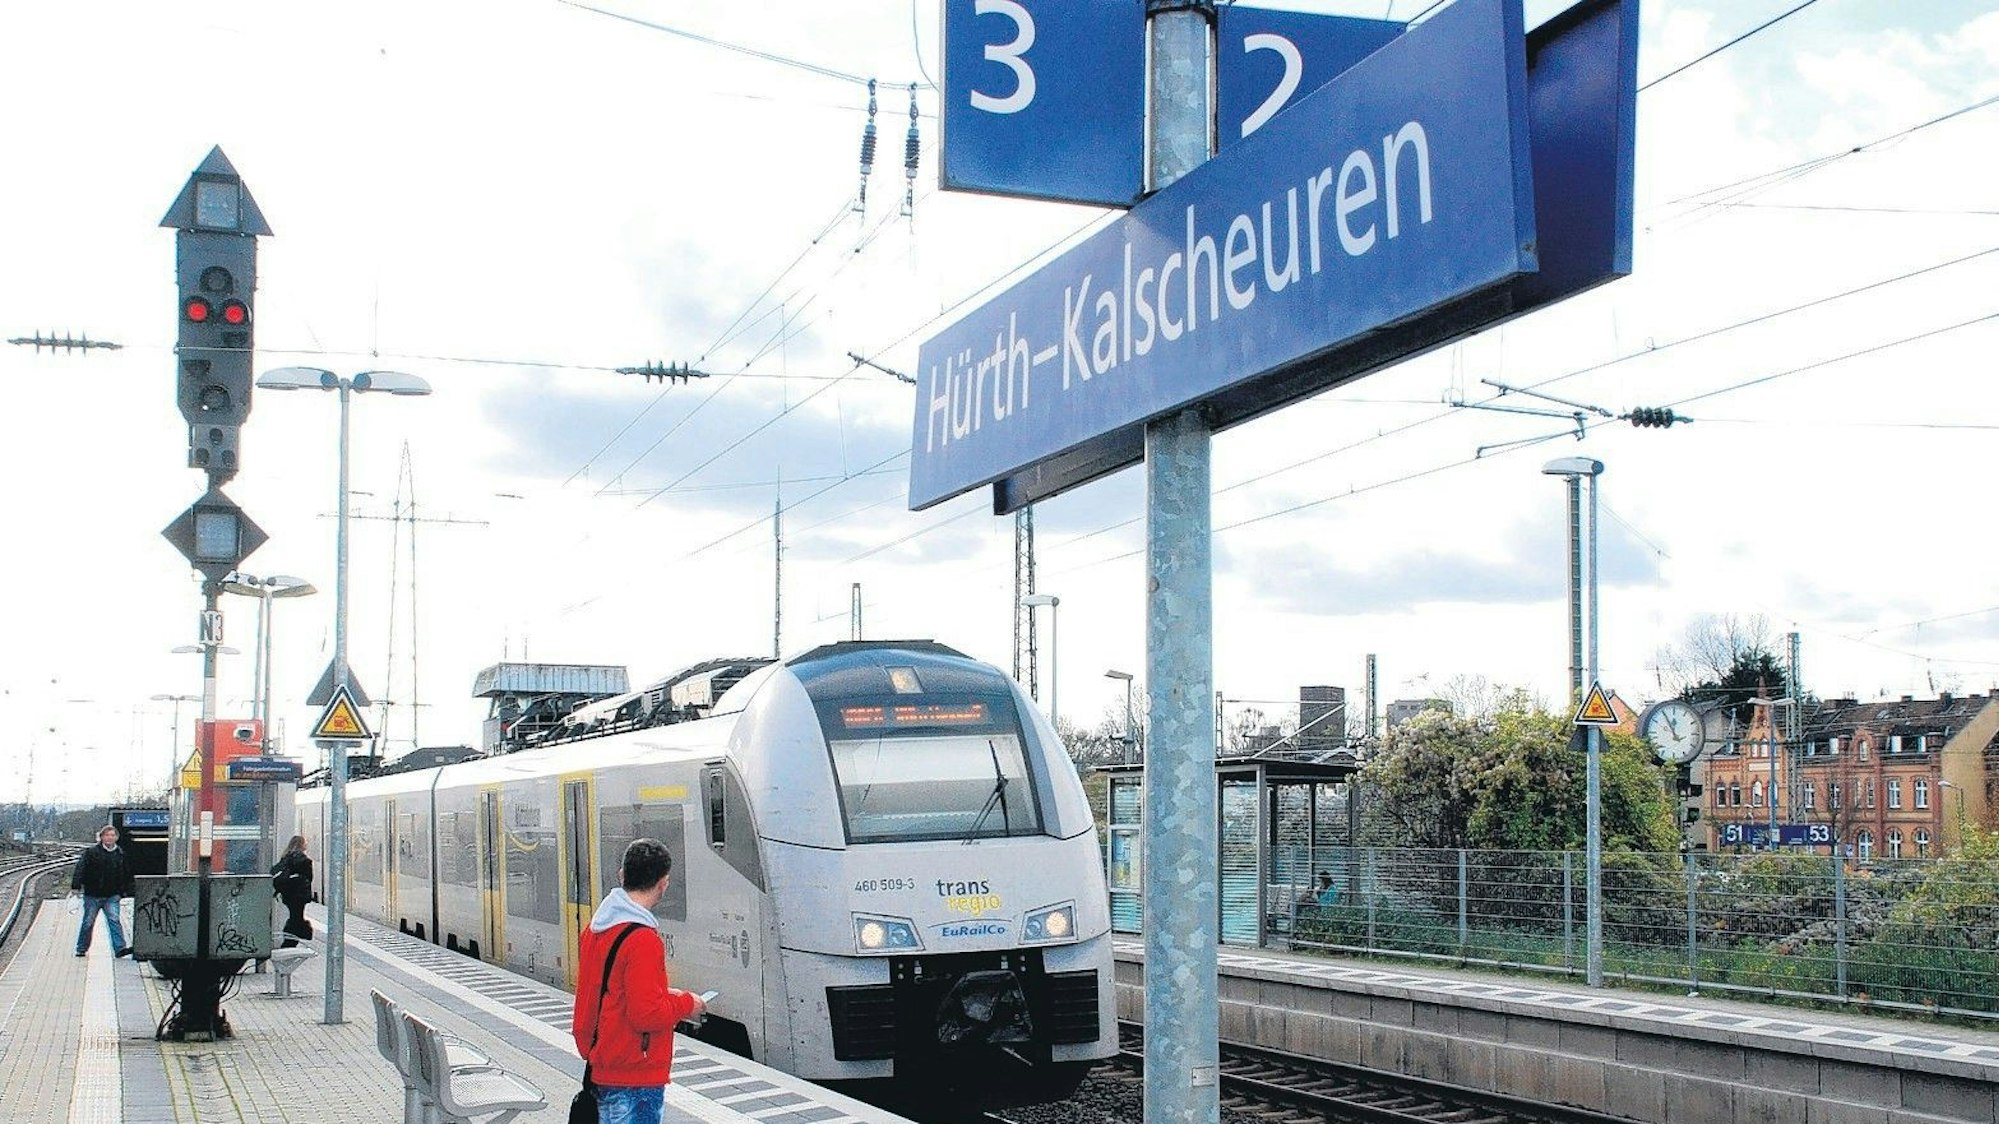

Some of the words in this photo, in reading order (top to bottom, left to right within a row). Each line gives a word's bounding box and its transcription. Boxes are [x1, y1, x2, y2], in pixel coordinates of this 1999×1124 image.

[969, 0, 1037, 115] 3
[1240, 33, 1303, 138] 2
[927, 120, 1434, 453] Hürth-Kalscheuren
[200, 613, 223, 641] N3
[1726, 824, 1743, 842] 51
[1809, 824, 1830, 842] 53
[854, 879, 877, 892] 460
[935, 877, 990, 897] trans
[947, 895, 1002, 916] regio
[941, 923, 1006, 938] EuRailCo
